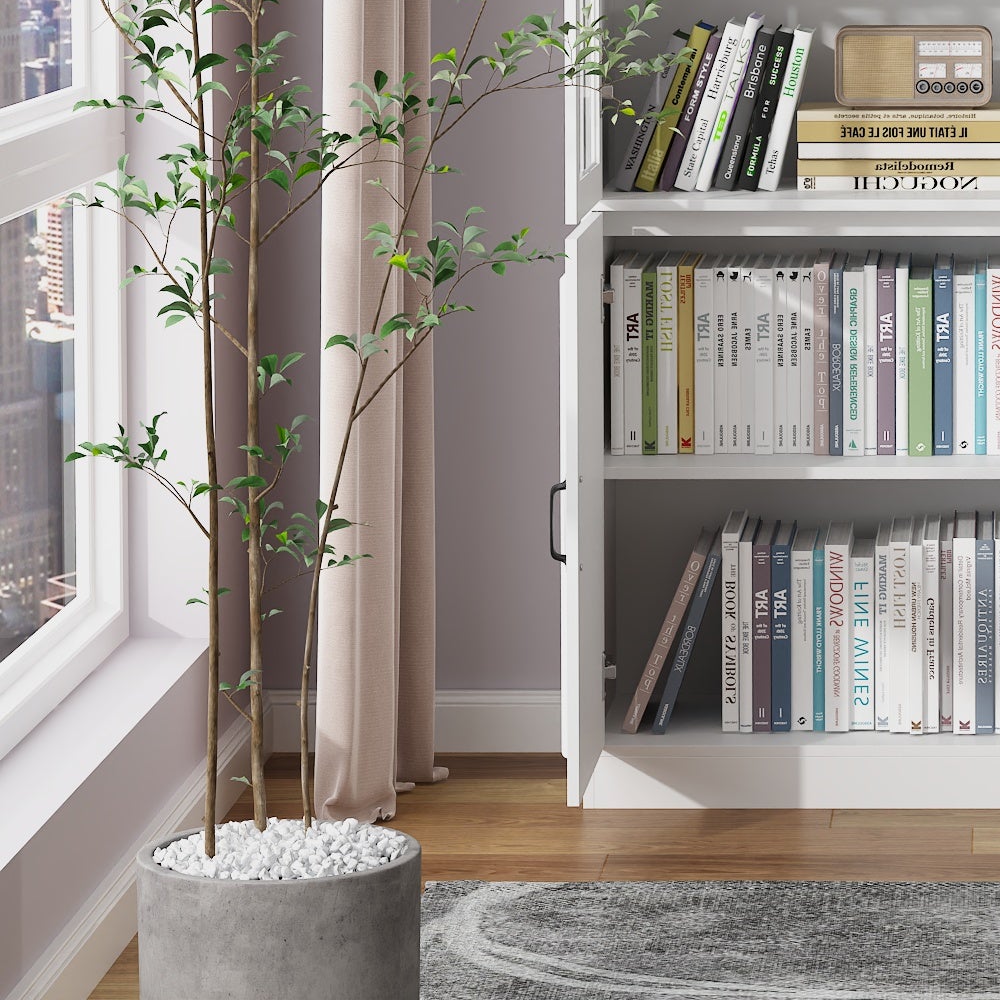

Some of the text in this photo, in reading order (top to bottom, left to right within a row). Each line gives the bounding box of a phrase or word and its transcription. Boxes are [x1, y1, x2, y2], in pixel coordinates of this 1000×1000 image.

[685, 52, 713, 121] FORM STYLE
[707, 38, 736, 99] Harrisburg
[744, 45, 766, 98] Brisbane
[783, 48, 804, 97] Houston
[747, 46, 784, 176] FORMULA FOR SUCCESS
[725, 135, 741, 179] Queensland
